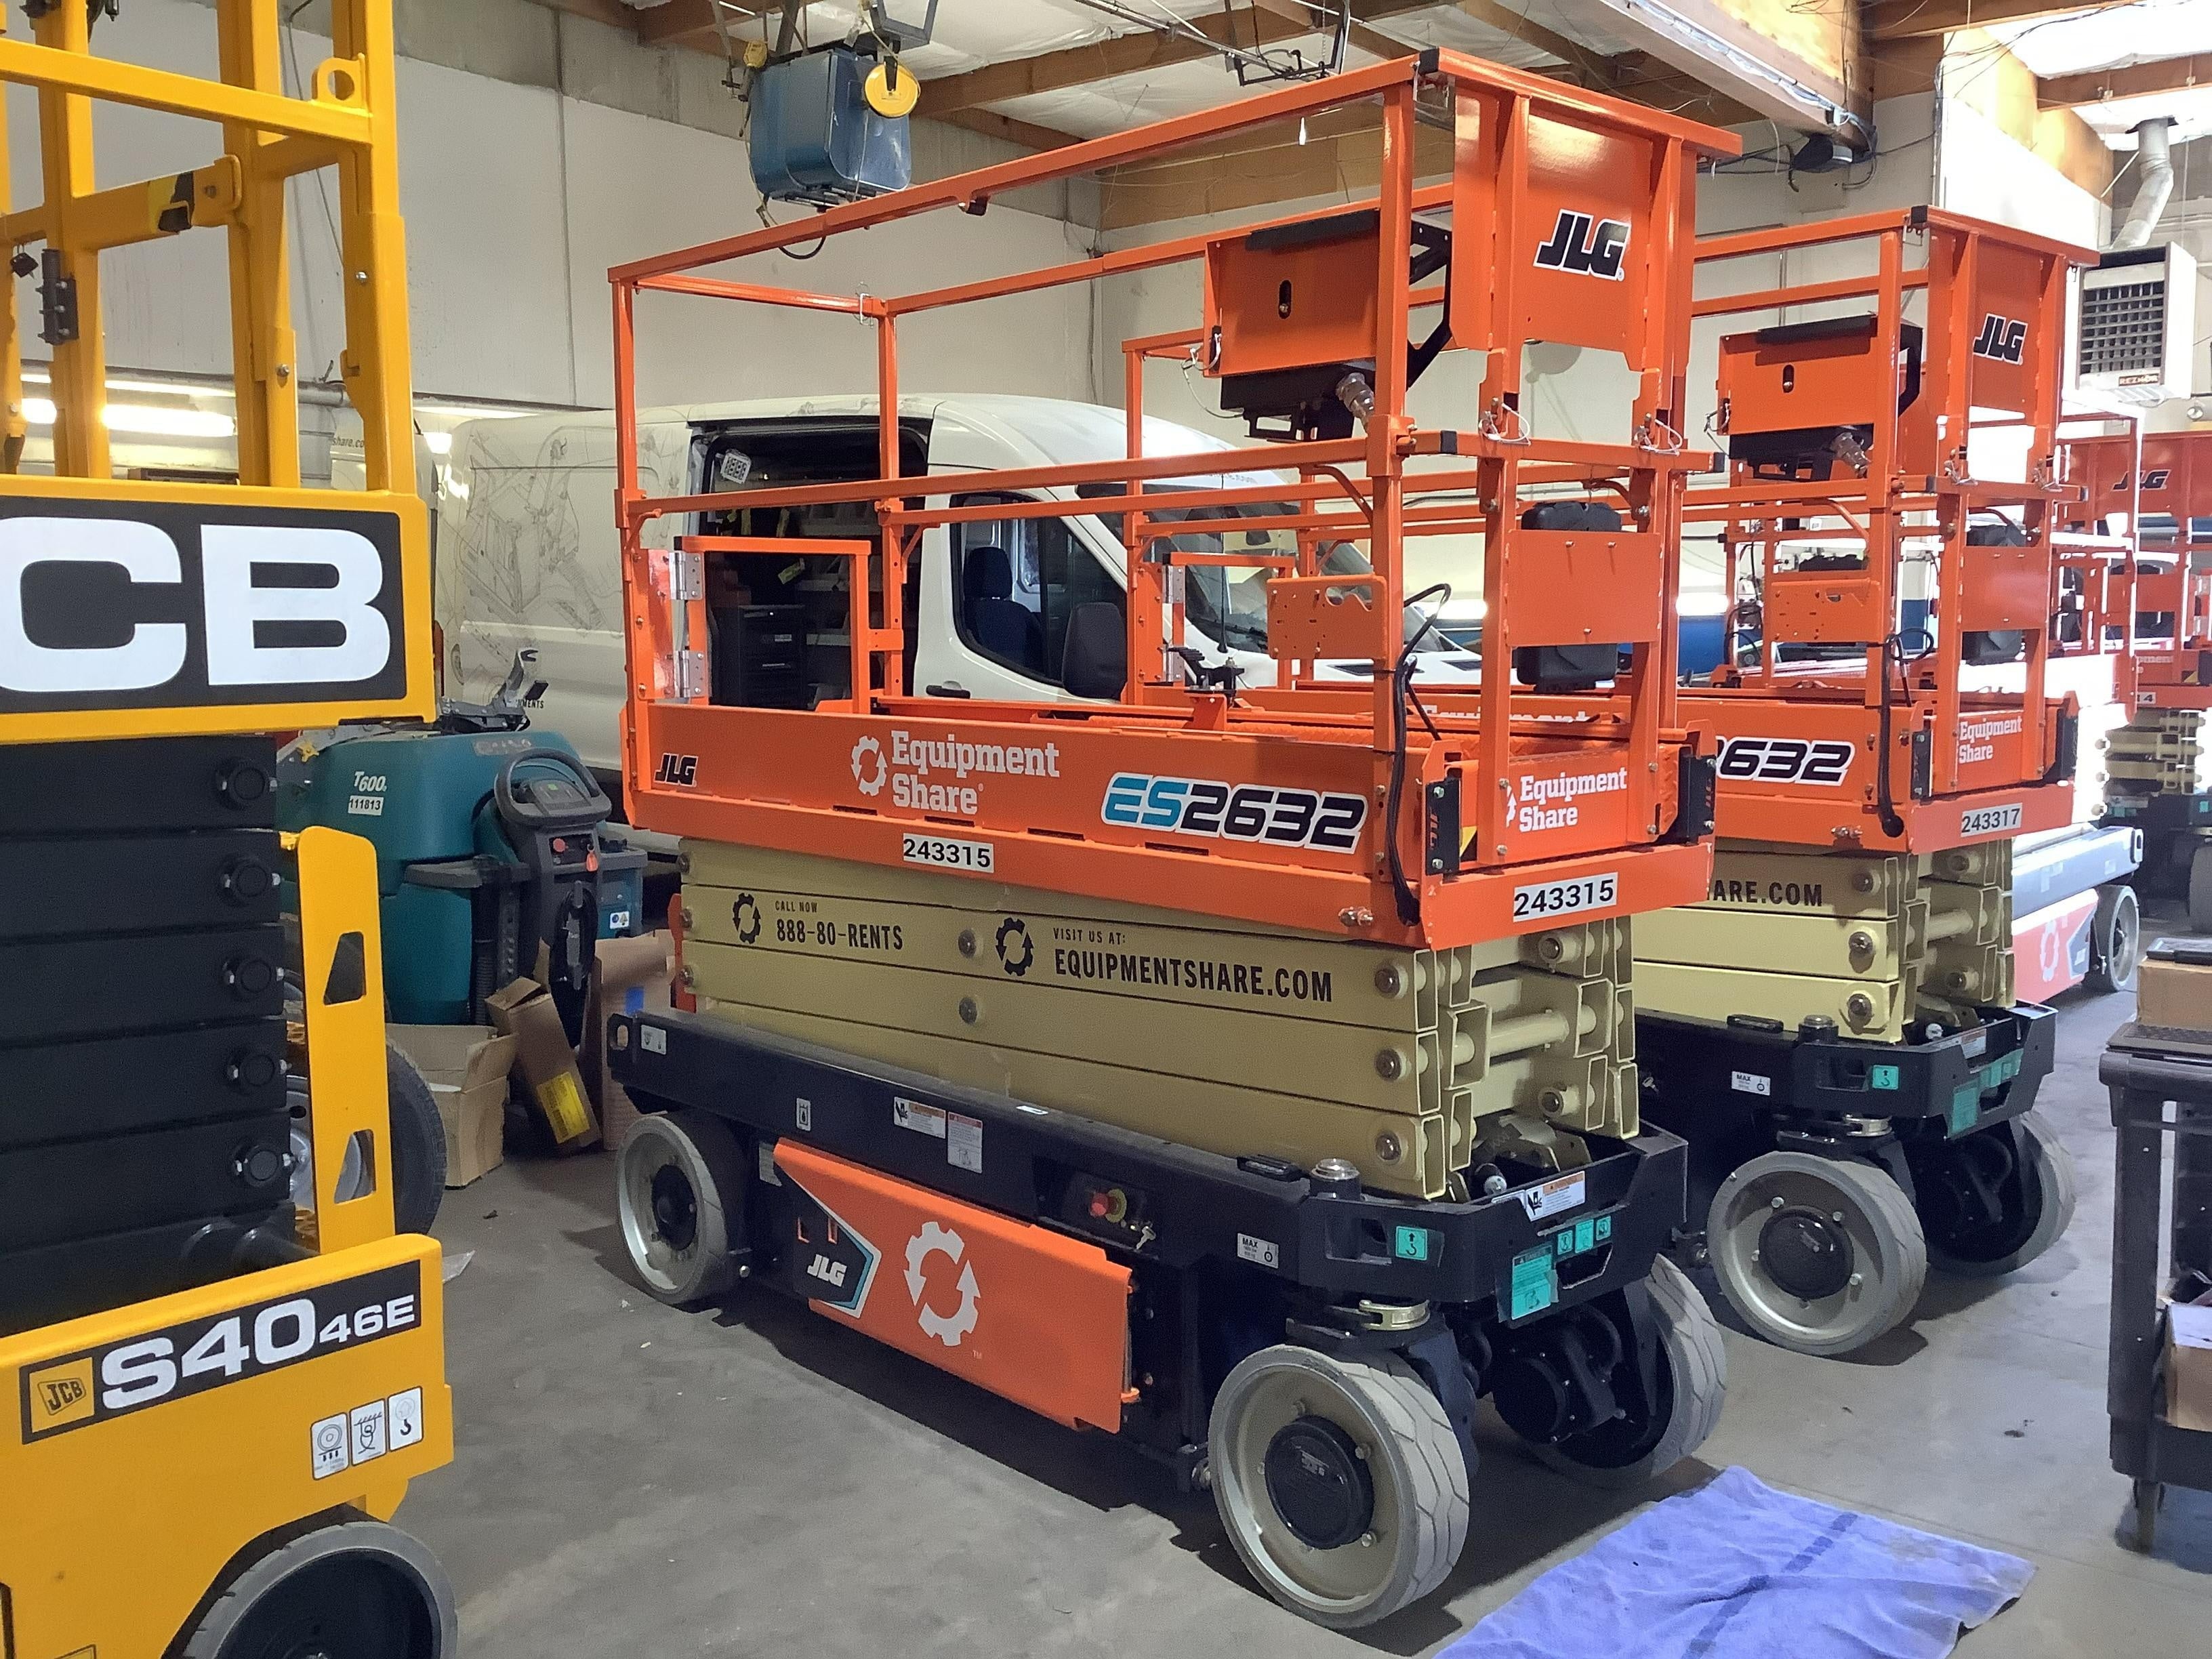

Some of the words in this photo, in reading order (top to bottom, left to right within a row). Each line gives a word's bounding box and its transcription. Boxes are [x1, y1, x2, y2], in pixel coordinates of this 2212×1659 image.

[1536, 211, 1630, 278] JLG
[1972, 314, 2027, 363] JLG
[331, 435, 365, 447] share.co
[1959, 716, 2023, 743] Equipment
[655, 754, 697, 786] JLG
[891, 730, 1060, 779] Equipment
[1717, 737, 1856, 783] 632
[1959, 744, 1994, 764] Share
[354, 771, 386, 792] T600
[892, 773, 978, 815] Share
[1519, 767, 1627, 804] Equipment
[348, 798, 381, 811] 111813
[1104, 775, 1366, 851] ES2632
[1519, 806, 1578, 833] Share
[1961, 808, 2021, 833] 243317
[903, 838, 991, 868] 243315
[775, 900, 796, 912] CALL
[799, 901, 818, 913] NOW
[1513, 878, 1615, 917] 243315
[1712, 879, 1822, 907] ARE.COM
[777, 918, 903, 950] 888-80-RENTS
[1053, 927, 1083, 942] VISIT
[1088, 930, 1103, 943] US
[1108, 932, 1126, 945] AT:
[1055, 949, 1333, 1002] EQUIPMENTSHARE.COM
[1242, 1237, 1258, 1248] MAX
[806, 1253, 848, 1288] JLG
[46, 1378, 83, 1411] JCB
